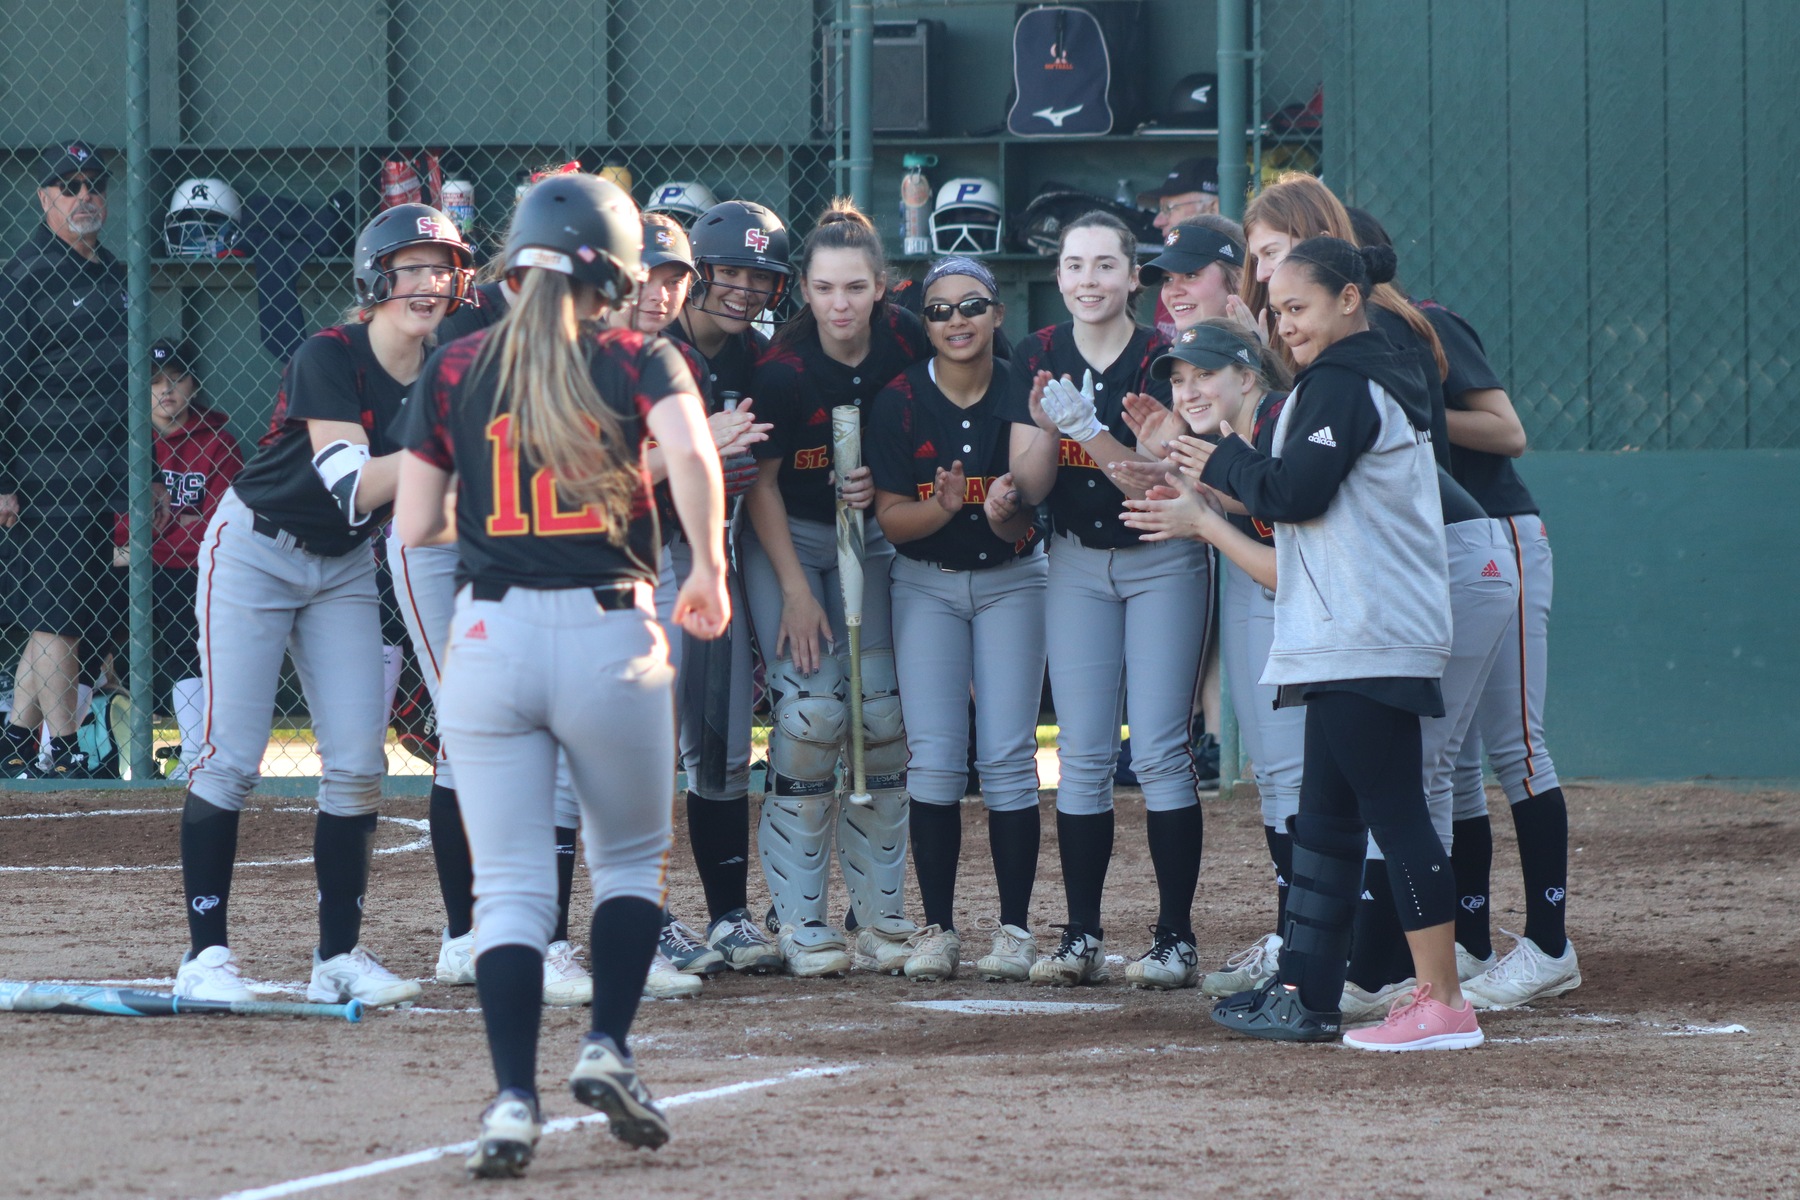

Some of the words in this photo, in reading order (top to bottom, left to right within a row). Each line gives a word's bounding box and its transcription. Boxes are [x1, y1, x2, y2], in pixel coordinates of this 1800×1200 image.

[658, 187, 683, 205] P
[955, 183, 982, 203] P
[417, 216, 441, 239] SF
[745, 228, 770, 253] SF
[1308, 435, 1337, 448] adidas
